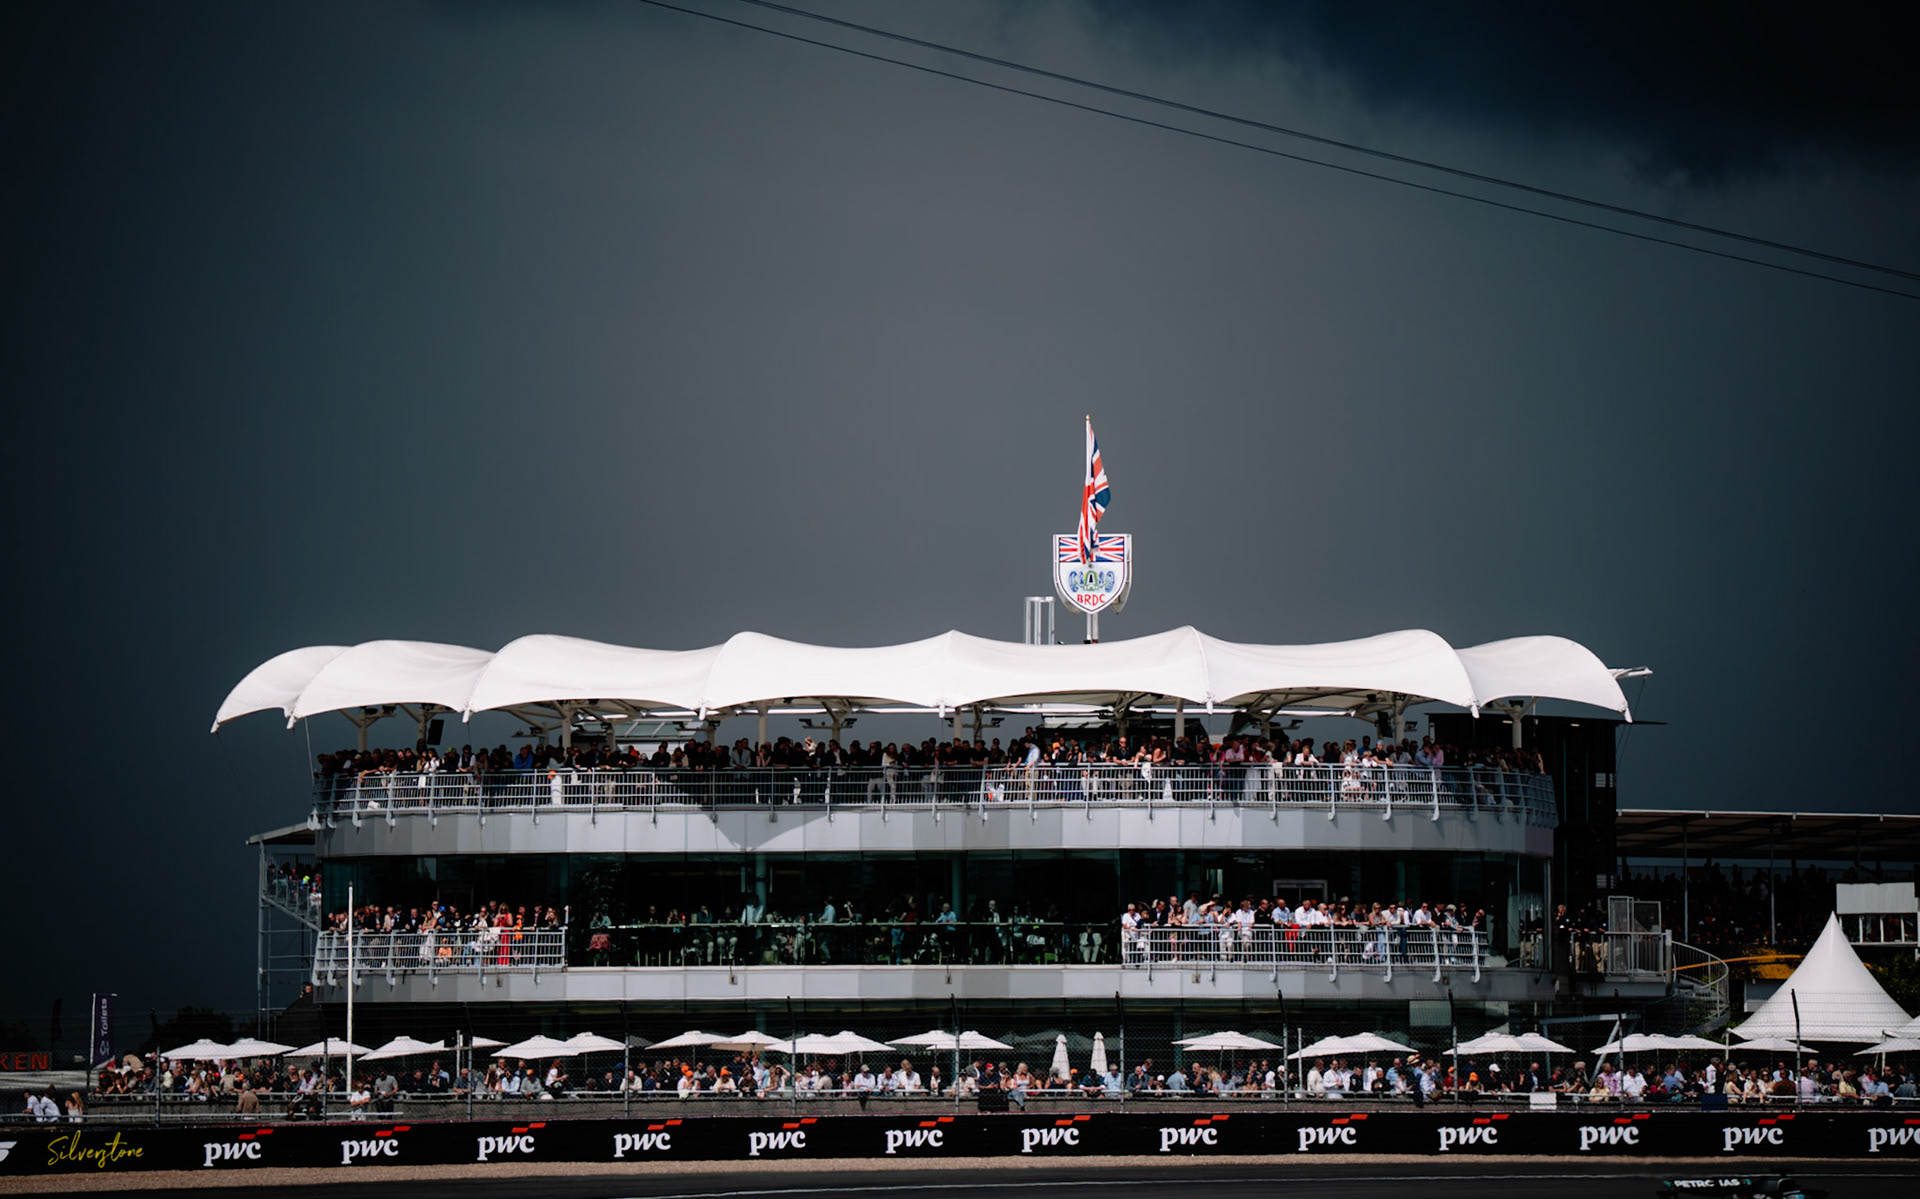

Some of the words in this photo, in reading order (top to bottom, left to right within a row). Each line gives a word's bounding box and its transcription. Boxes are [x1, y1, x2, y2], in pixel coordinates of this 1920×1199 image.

[1076, 593, 1105, 606] BRDC
[47, 1129, 145, 1169] Silverstone
[476, 1135, 535, 1161] pwc
[613, 1132, 672, 1158] pwc
[748, 1130, 806, 1156] pwc
[884, 1129, 944, 1154] pwc
[1020, 1127, 1080, 1153] pwc
[1159, 1127, 1218, 1152] pwc
[1297, 1126, 1357, 1152] pwc
[1437, 1126, 1498, 1151] pwc
[1579, 1125, 1640, 1151] pwc
[1722, 1126, 1784, 1151] pwc
[203, 1140, 262, 1167] pwc
[340, 1138, 399, 1165] pwc
